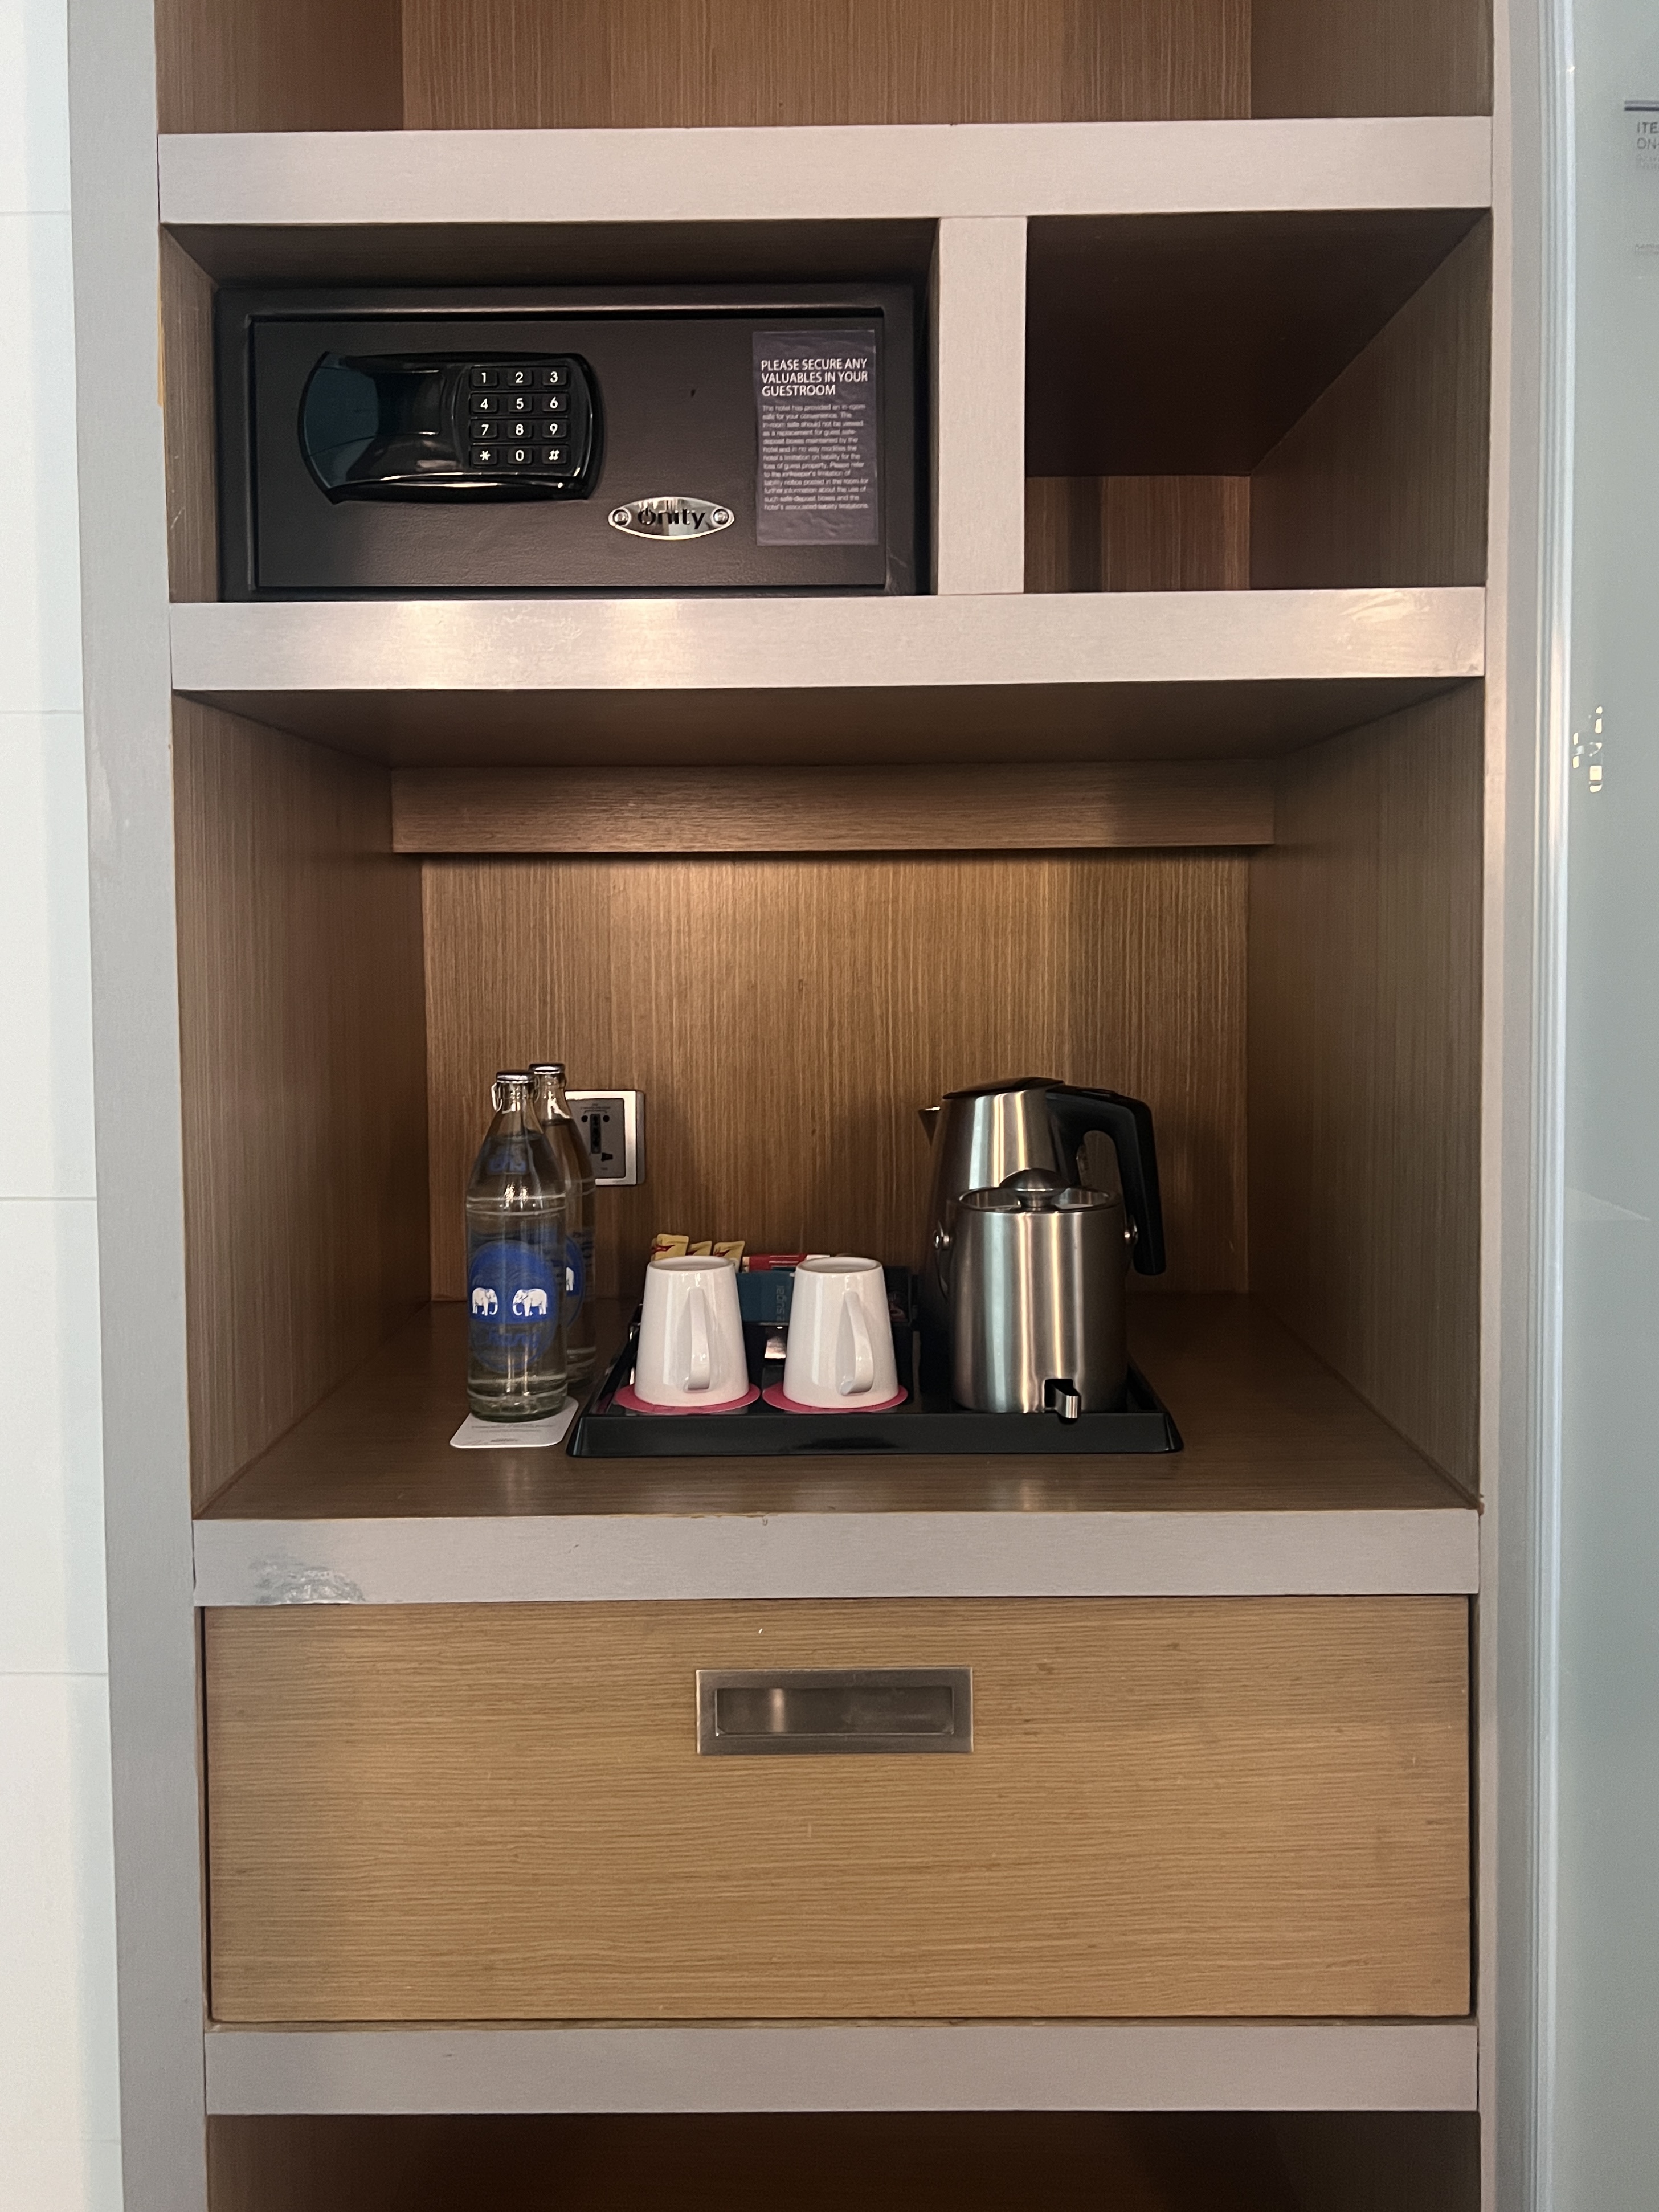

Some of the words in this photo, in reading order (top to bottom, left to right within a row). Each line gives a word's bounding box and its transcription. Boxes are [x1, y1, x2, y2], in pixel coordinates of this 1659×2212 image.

[761, 359, 799, 371] PLEASE
[802, 359, 843, 370] SECURE
[844, 358, 868, 370] ANY
[481, 372, 487, 383] 1
[515, 371, 524, 383] 2
[550, 371, 558, 383] 3
[762, 371, 822, 384] VALUABLES
[824, 371, 836, 383] IN
[838, 370, 868, 382] YOUR
[762, 385, 836, 396] GUESTROOM
[480, 398, 488, 410] 4
[516, 398, 524, 410] 5
[550, 396, 558, 409] 6
[481, 424, 489, 436] 7
[515, 423, 524, 436] 8
[549, 423, 558, 435] 9
[515, 449, 524, 461] 0
[548, 449, 560, 461] #
[638, 506, 706, 529] Onity
[775, 1285, 787, 1315] sugar
